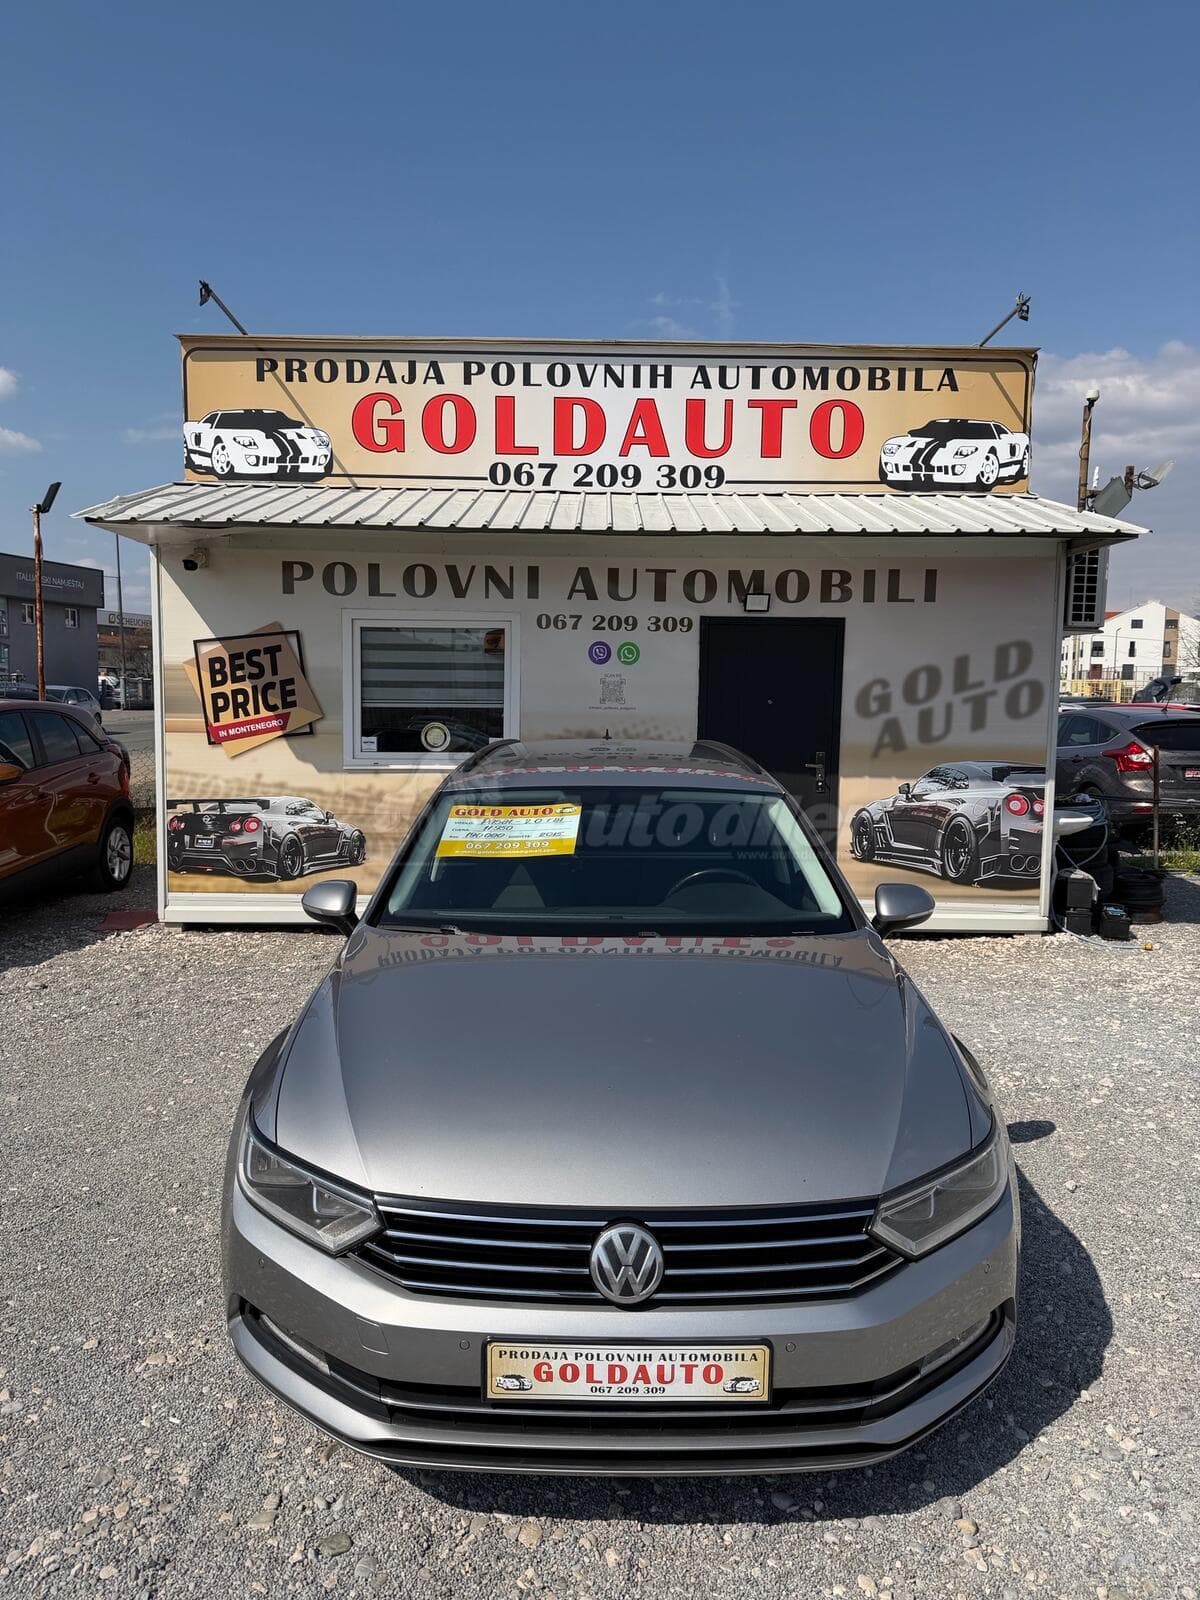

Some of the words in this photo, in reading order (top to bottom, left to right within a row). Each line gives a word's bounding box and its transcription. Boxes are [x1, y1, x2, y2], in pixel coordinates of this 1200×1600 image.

[255, 357, 446, 386] PRODAJA
[463, 360, 673, 390] POLOVNIH
[690, 364, 959, 393] AUTOMOBILA
[351, 392, 865, 460] GOLDAUTO
[489, 462, 558, 487] 067
[573, 463, 642, 488] 209
[656, 464, 725, 490] 309
[281, 559, 540, 600] POLOVNI
[566, 565, 938, 604] AUTOMOBILI
[535, 612, 582, 630] 067
[591, 613, 639, 632] 209
[646, 615, 694, 633] 309
[208, 643, 283, 689] BEST
[855, 639, 1034, 720] GOLD
[211, 676, 298, 723] PRICE
[218, 729, 228, 738] IN
[228, 718, 285, 736] MONTENEGRO
[870, 678, 1045, 761] AUTO
[454, 806, 503, 817] GOLD
[507, 806, 554, 817] AUTO
[465, 841, 491, 849] 067
[495, 841, 520, 849] 209
[524, 840, 549, 848] 309
[498, 1349, 569, 1361] PRODAJA
[574, 1351, 653, 1363] POLOVNIH
[658, 1352, 759, 1363] AUTOMOBILA
[533, 1362, 724, 1385] GOLDAUTO
[590, 1385, 613, 1394] 067
[616, 1386, 640, 1395] 209
[643, 1386, 666, 1395] 309
